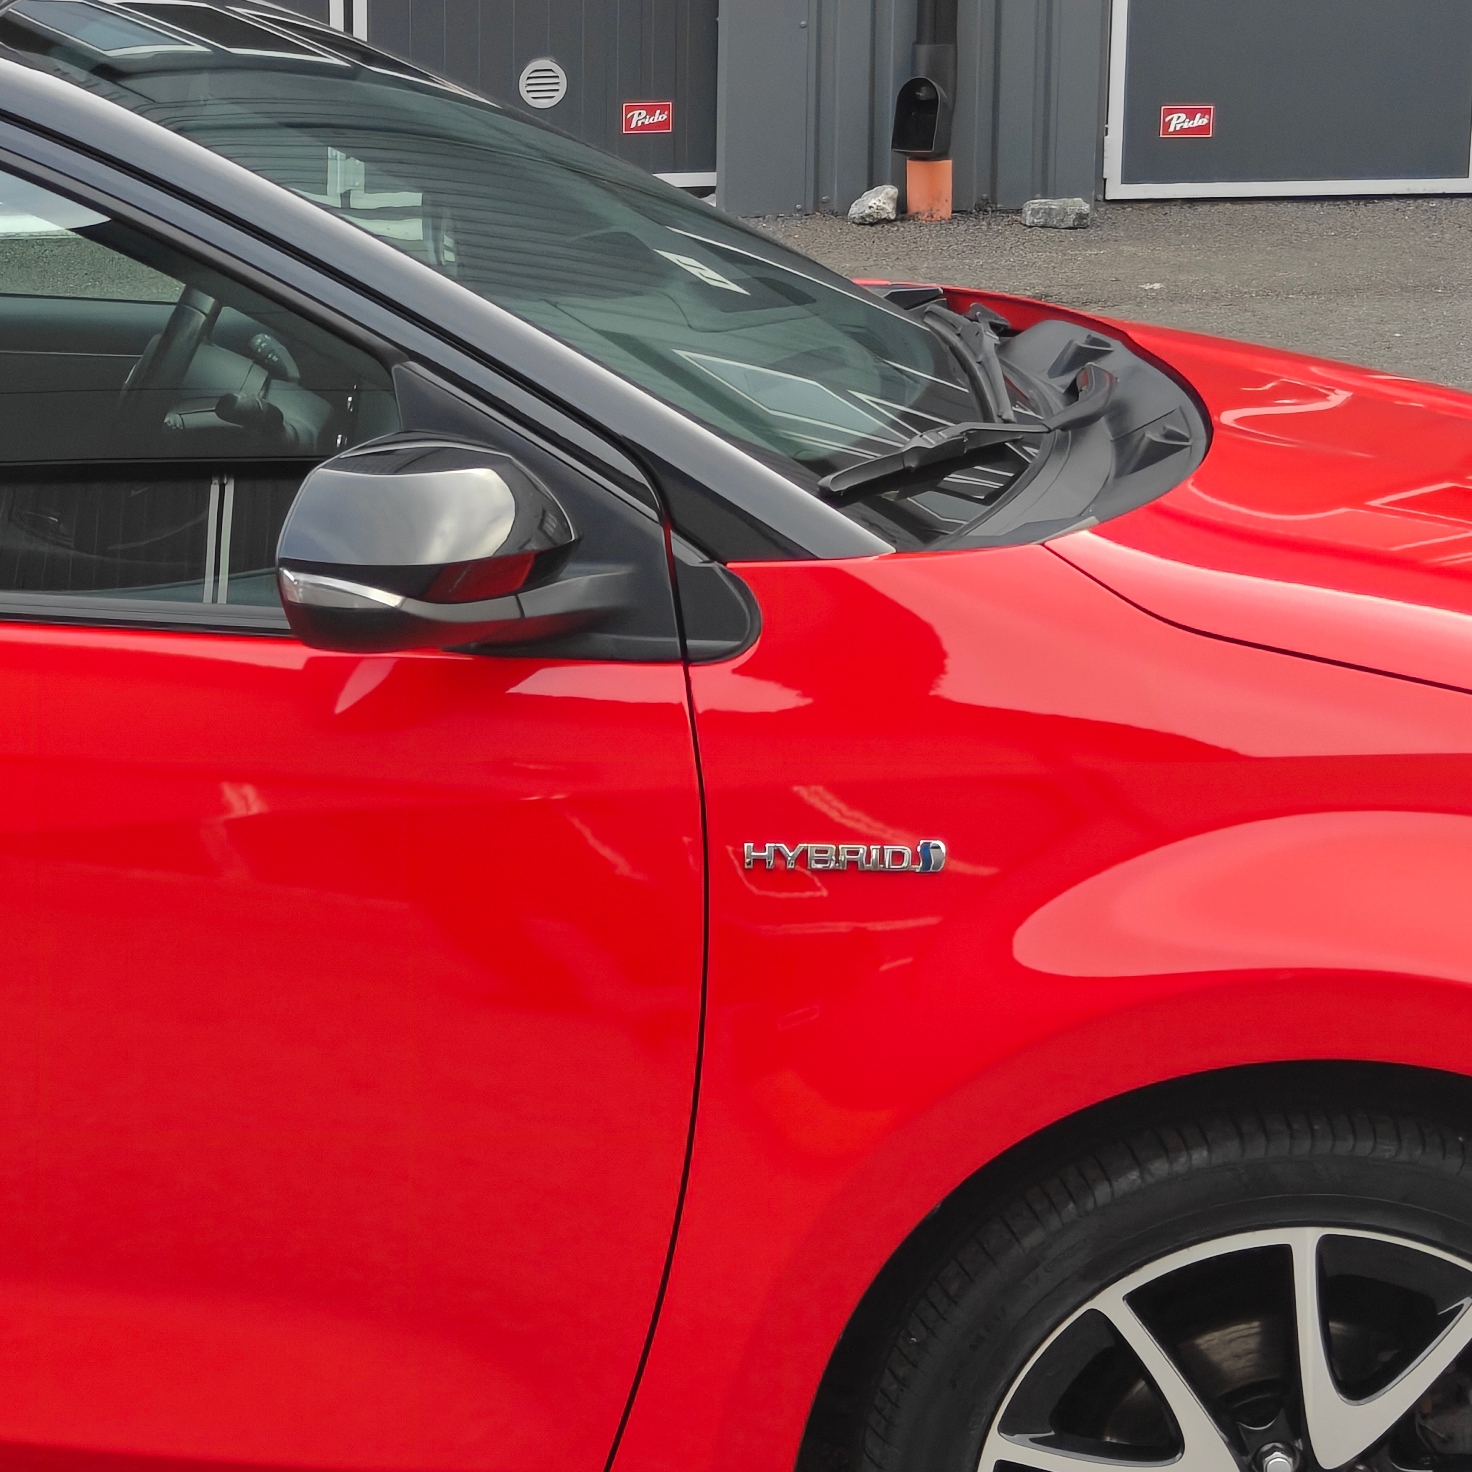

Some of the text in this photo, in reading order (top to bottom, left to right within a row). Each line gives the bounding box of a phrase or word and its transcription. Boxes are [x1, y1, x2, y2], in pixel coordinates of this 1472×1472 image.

[627, 109, 668, 129] Prido
[1165, 113, 1209, 133] Prido
[743, 843, 912, 870] HYBRID
